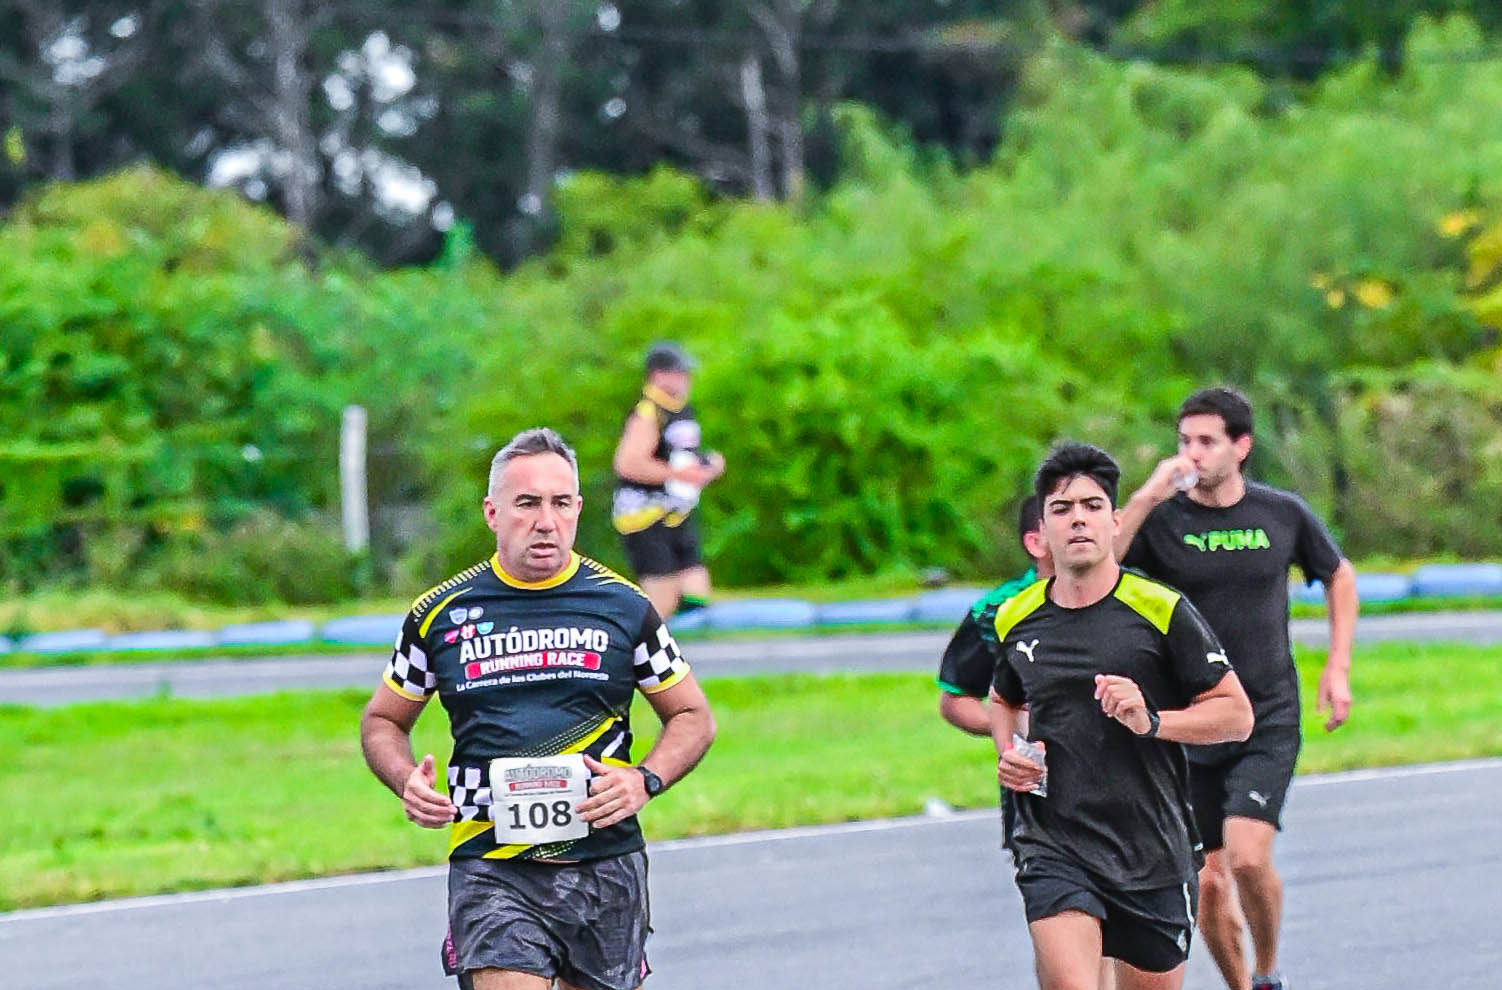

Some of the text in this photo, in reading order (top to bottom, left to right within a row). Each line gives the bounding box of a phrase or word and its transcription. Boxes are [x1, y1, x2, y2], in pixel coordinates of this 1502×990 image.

[1208, 529, 1270, 552] PUMA
[459, 626, 609, 664] AUTÓDROMO
[480, 652, 586, 675] RUNNING RACE
[508, 800, 572, 830] 108
